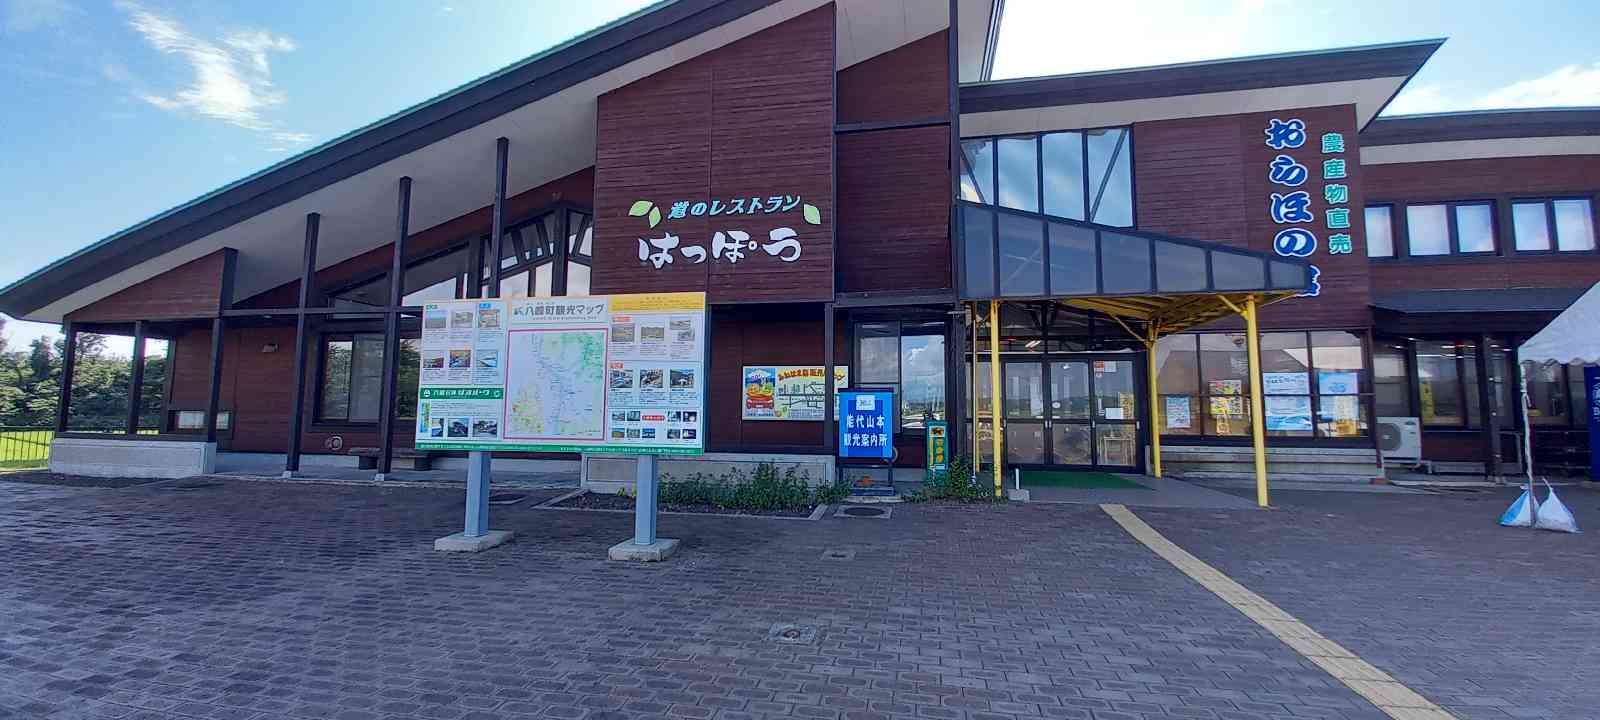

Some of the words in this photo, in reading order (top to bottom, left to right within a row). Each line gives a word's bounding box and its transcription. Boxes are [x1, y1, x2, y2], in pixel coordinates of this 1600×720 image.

[667, 194, 801, 220] 道のレストラン
[1265, 118, 1321, 296] おらほの
[1321, 132, 1353, 255] 農産物直売
[637, 226, 802, 269] はっぽう
[846, 414, 885, 429] 能代山本
[843, 432, 888, 447] 観光案内所
